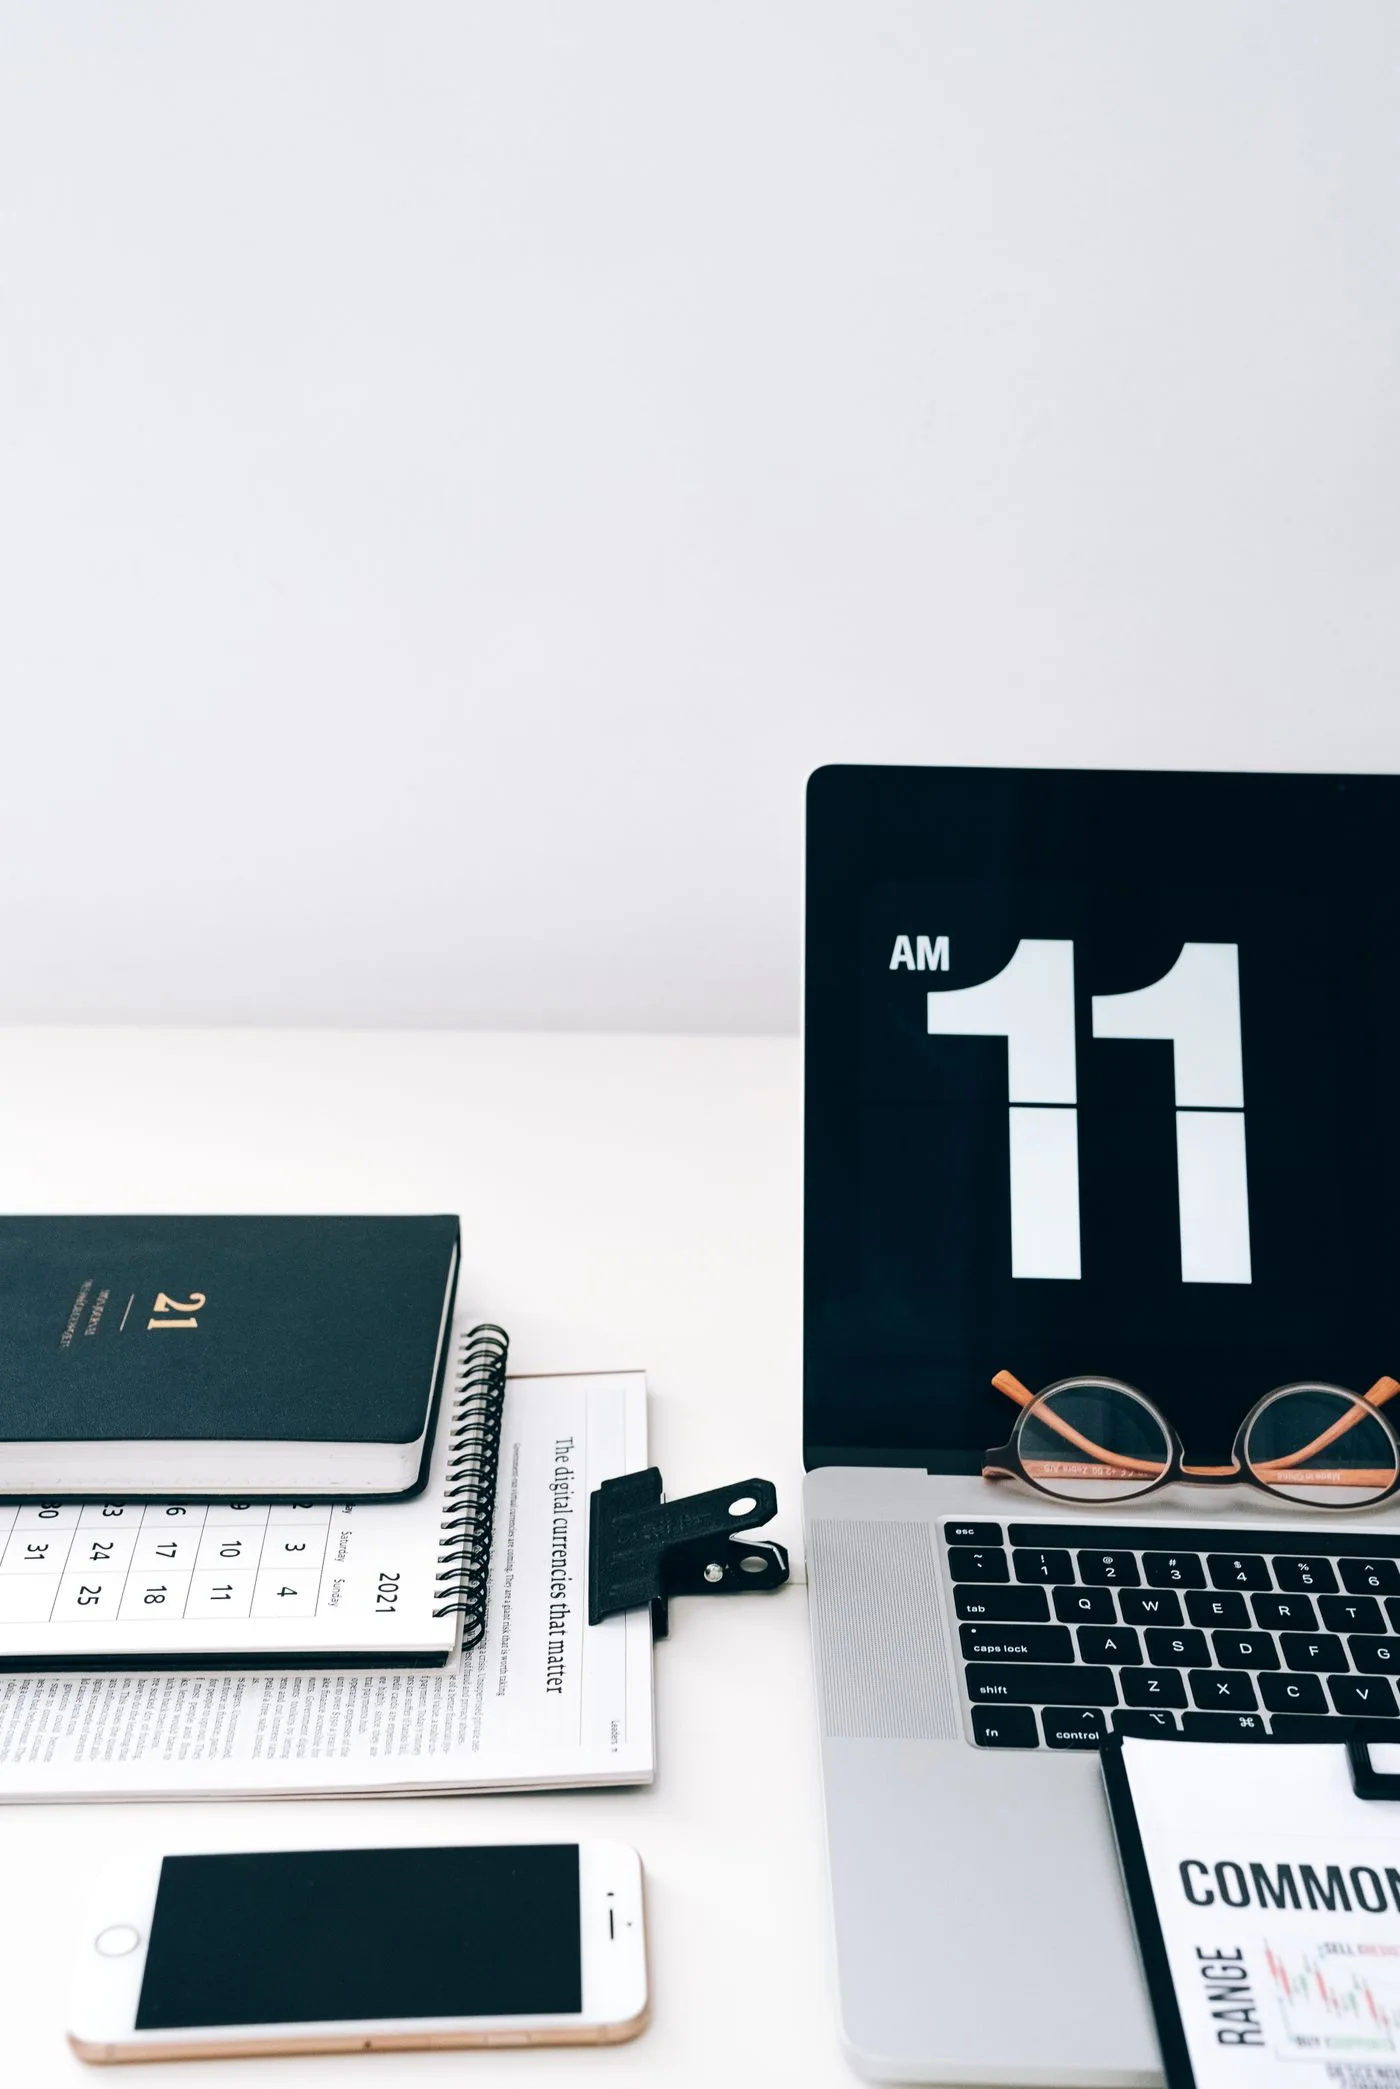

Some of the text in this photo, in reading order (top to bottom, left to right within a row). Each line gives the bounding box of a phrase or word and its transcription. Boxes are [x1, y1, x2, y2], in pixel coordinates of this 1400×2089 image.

[890, 935, 950, 971] AM
[927, 939, 1252, 1285] 11
[148, 1293, 205, 1329] 21
[24, 1544, 49, 1560] 31
[89, 1542, 114, 1561] 24
[155, 1542, 178, 1558] 17
[219, 1540, 242, 1558] 10
[284, 1543, 306, 1552] 3
[334, 1531, 352, 1563] Saturday
[546, 1436, 575, 1694] The digital currencies that matter
[1040, 1565, 1048, 1576] 1
[1105, 1567, 1116, 1578] 2
[1170, 1569, 1182, 1580] 3
[1236, 1572, 1248, 1582] 4
[1302, 1574, 1314, 1584] 5
[1368, 1576, 1380, 1586] 6
[77, 1585, 102, 1606] 25
[143, 1585, 168, 1605] 18
[210, 1584, 233, 1600] 11
[276, 1586, 298, 1597] 4
[327, 1579, 346, 1608] Sunday
[375, 1572, 401, 1613] 2021
[504, 1588, 512, 1600] are
[966, 1605, 986, 1613] tab
[1078, 1598, 1091, 1610] Q
[1142, 1600, 1159, 1612] W
[1212, 1603, 1224, 1614] E
[1278, 1605, 1291, 1616] R
[1345, 1607, 1357, 1618] T
[502, 1621, 511, 1634] risk
[501, 1635, 511, 1649] that
[1104, 1638, 1117, 1650] A
[1172, 1640, 1185, 1652] S
[973, 1645, 1028, 1654] caps lock
[1239, 1643, 1253, 1654] D
[1308, 1645, 1319, 1657] F
[1377, 1648, 1391, 1660] G
[499, 1655, 509, 1675] worth
[496, 1675, 507, 1697] taking
[979, 1685, 1008, 1694] shift
[1147, 1680, 1160, 1692] Z
[1216, 1683, 1230, 1695] X
[1286, 1685, 1300, 1698] C
[1355, 1688, 1369, 1700] V
[985, 1728, 999, 1737] fn
[1055, 1731, 1100, 1740] control
[1195, 1945, 1266, 2047] RANGE
